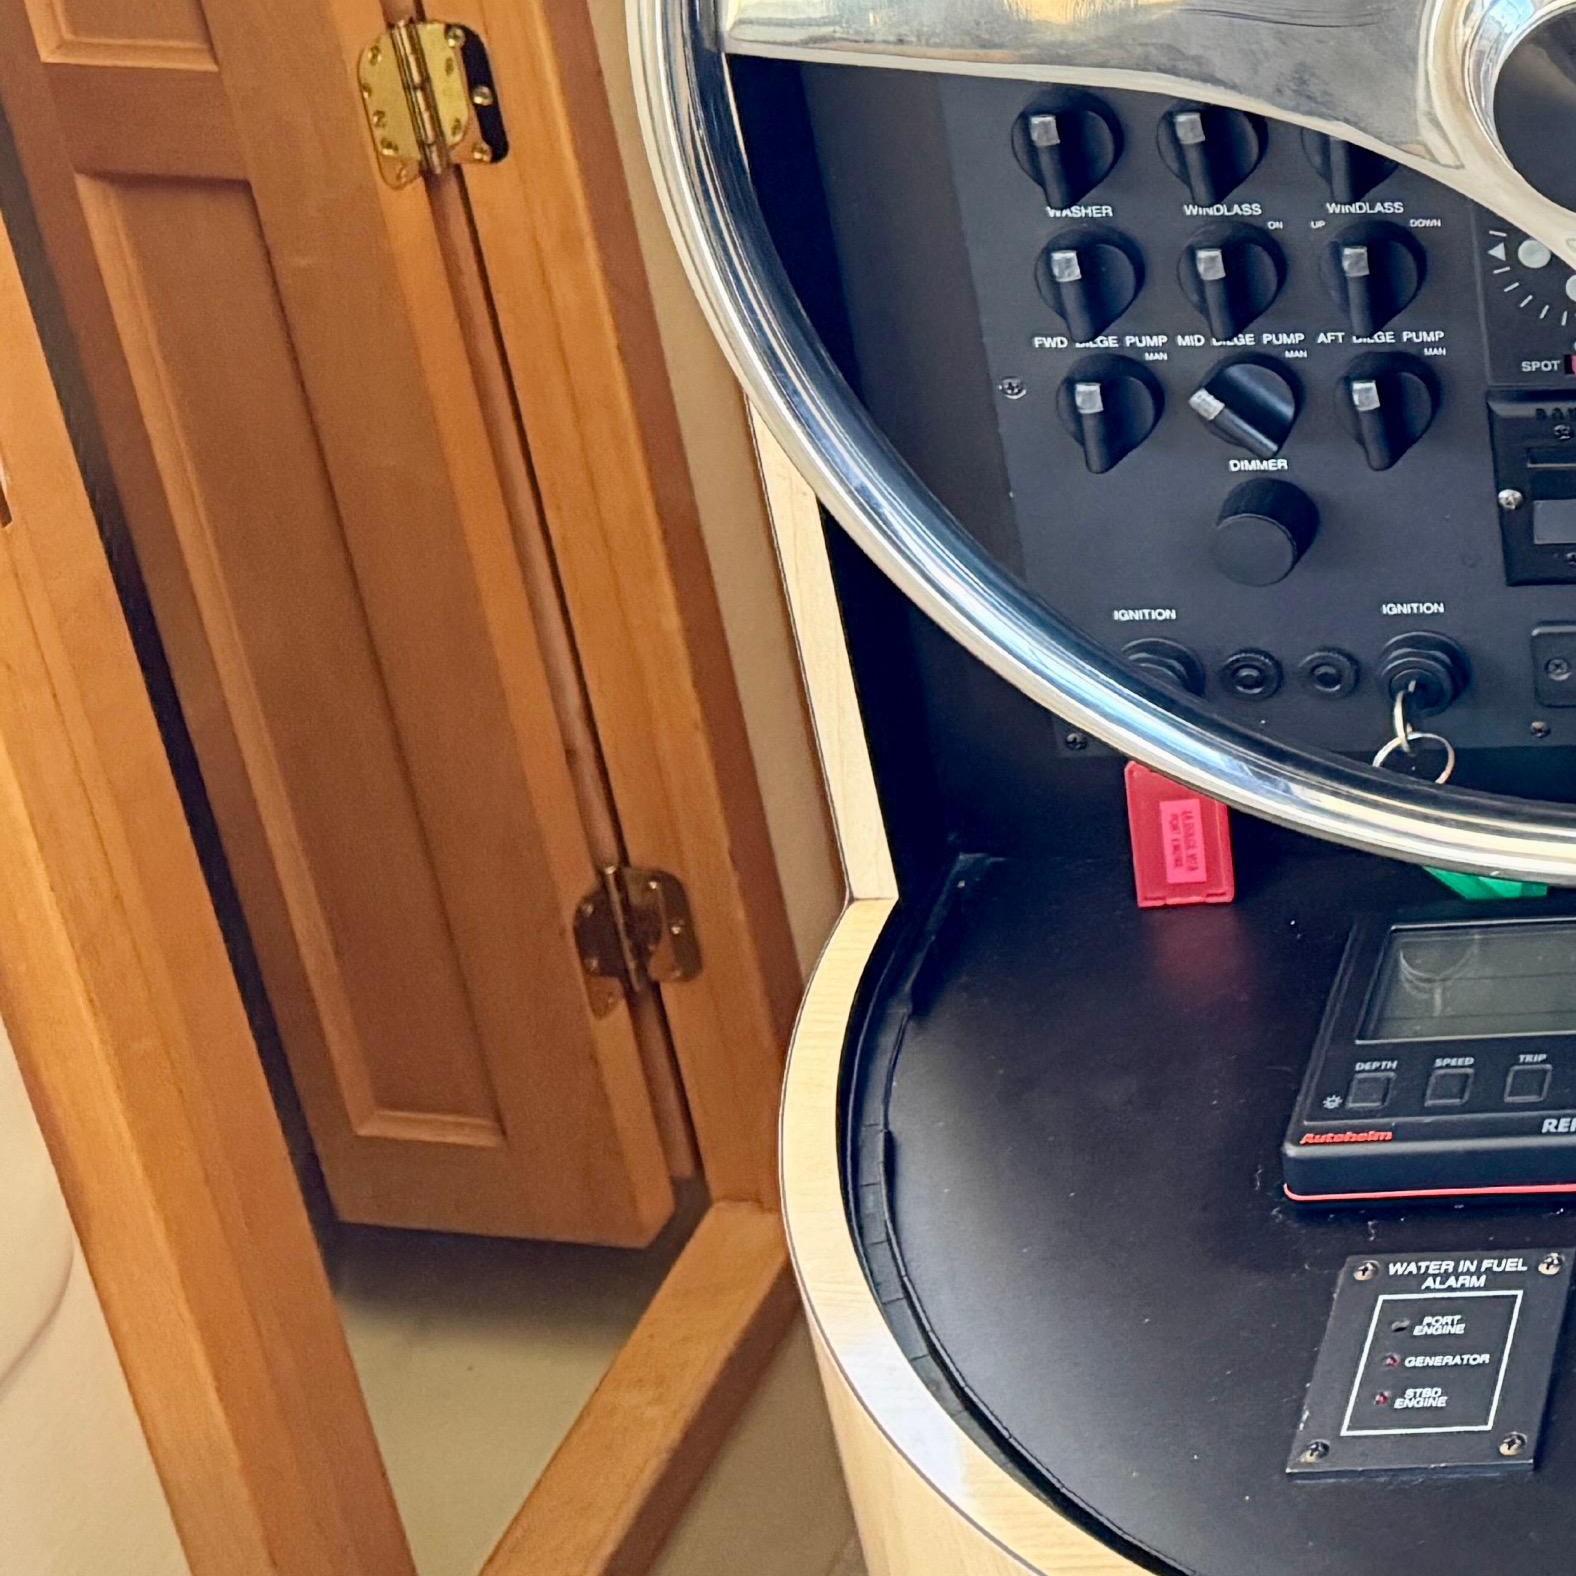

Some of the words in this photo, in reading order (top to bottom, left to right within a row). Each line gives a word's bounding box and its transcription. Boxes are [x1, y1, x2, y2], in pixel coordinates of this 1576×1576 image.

[1326, 202, 1403, 213] WINDLASS
[1410, 219, 1441, 227] DOWN
[1522, 360, 1560, 371] SPOT
[1229, 459, 1288, 471] DIMMER
[1383, 603, 1444, 614] IGNITION
[1435, 1057, 1474, 1067] SPEED
[1519, 1054, 1547, 1062] TRIP
[1355, 1061, 1397, 1071] DEPTH
[1301, 1131, 1392, 1144] Autohelm
[1389, 1261, 1454, 1275] WATER
[1458, 1260, 1477, 1272] IN
[1481, 1258, 1527, 1272] FUEL
[1421, 1275, 1486, 1289] ALARM
[1423, 1315, 1461, 1325] PORT
[1413, 1325, 1465, 1335] ENGINE
[1405, 1354, 1490, 1367] GENERATOR
[1405, 1387, 1441, 1397] STBD
[1394, 1397, 1447, 1408] ENGINE
